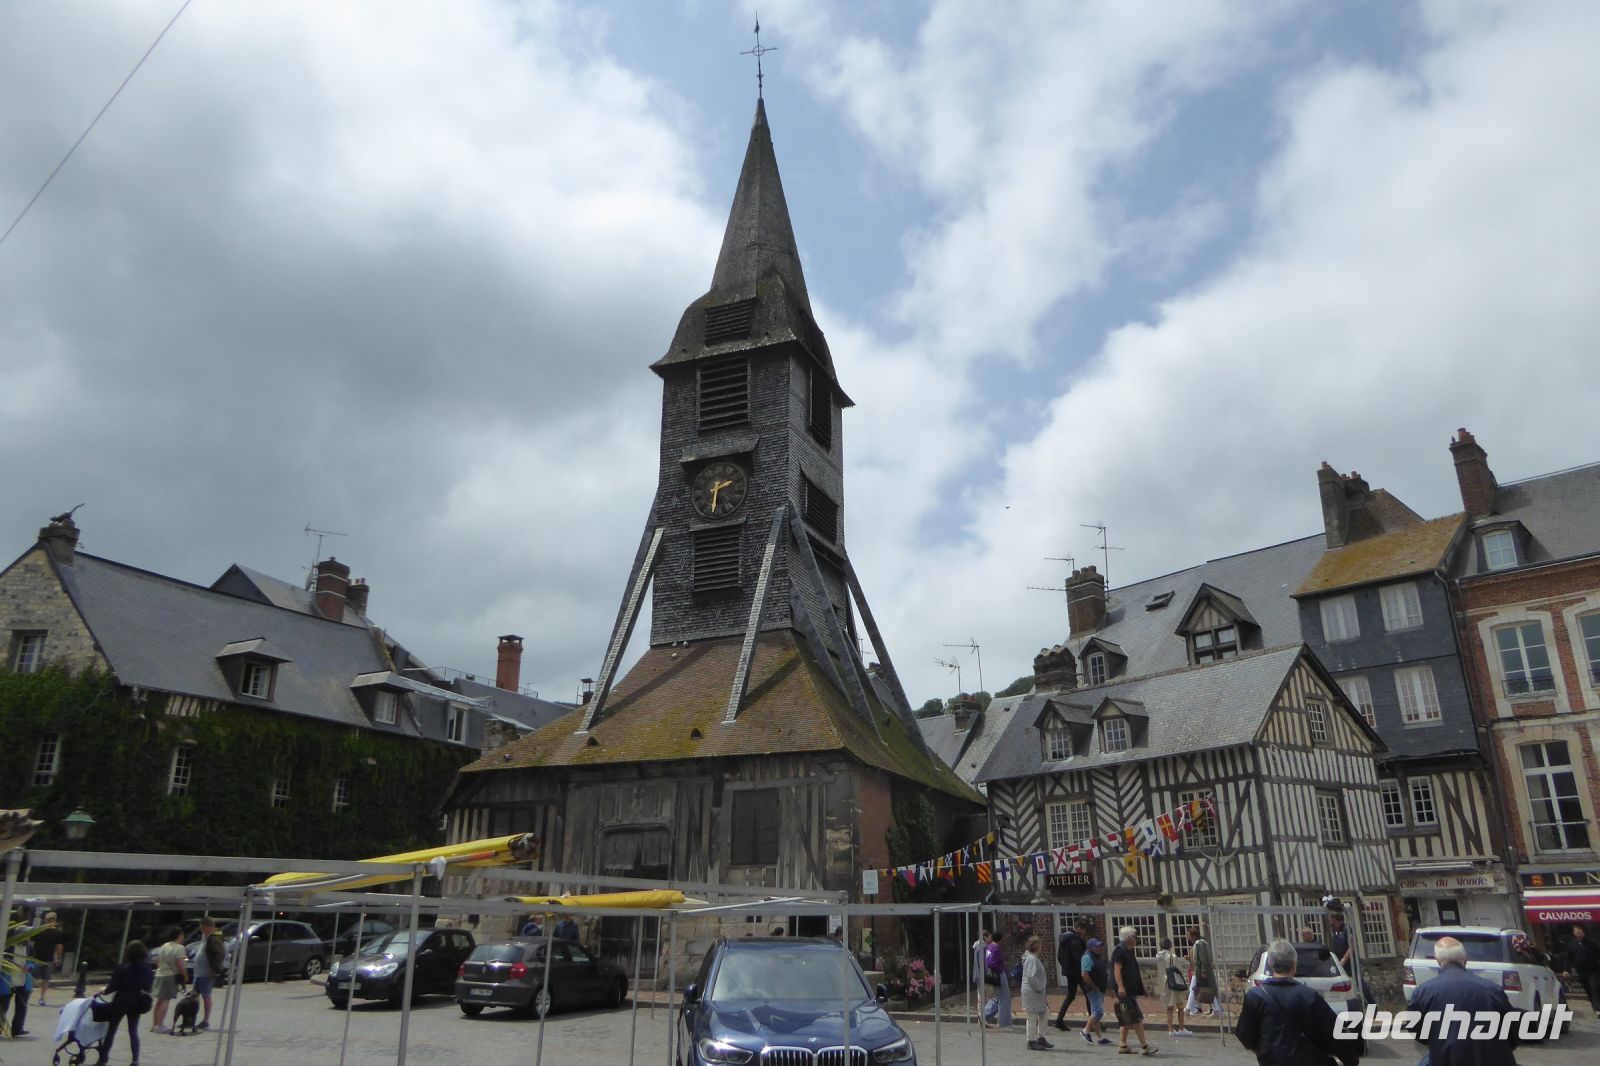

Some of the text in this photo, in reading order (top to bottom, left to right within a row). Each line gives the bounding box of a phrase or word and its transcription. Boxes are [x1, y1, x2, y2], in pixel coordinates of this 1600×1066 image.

[1049, 875, 1090, 886] ATELIER
[1435, 879, 1448, 887] du
[1456, 876, 1488, 886] Monde
[1538, 911, 1592, 921] CALVADOS
